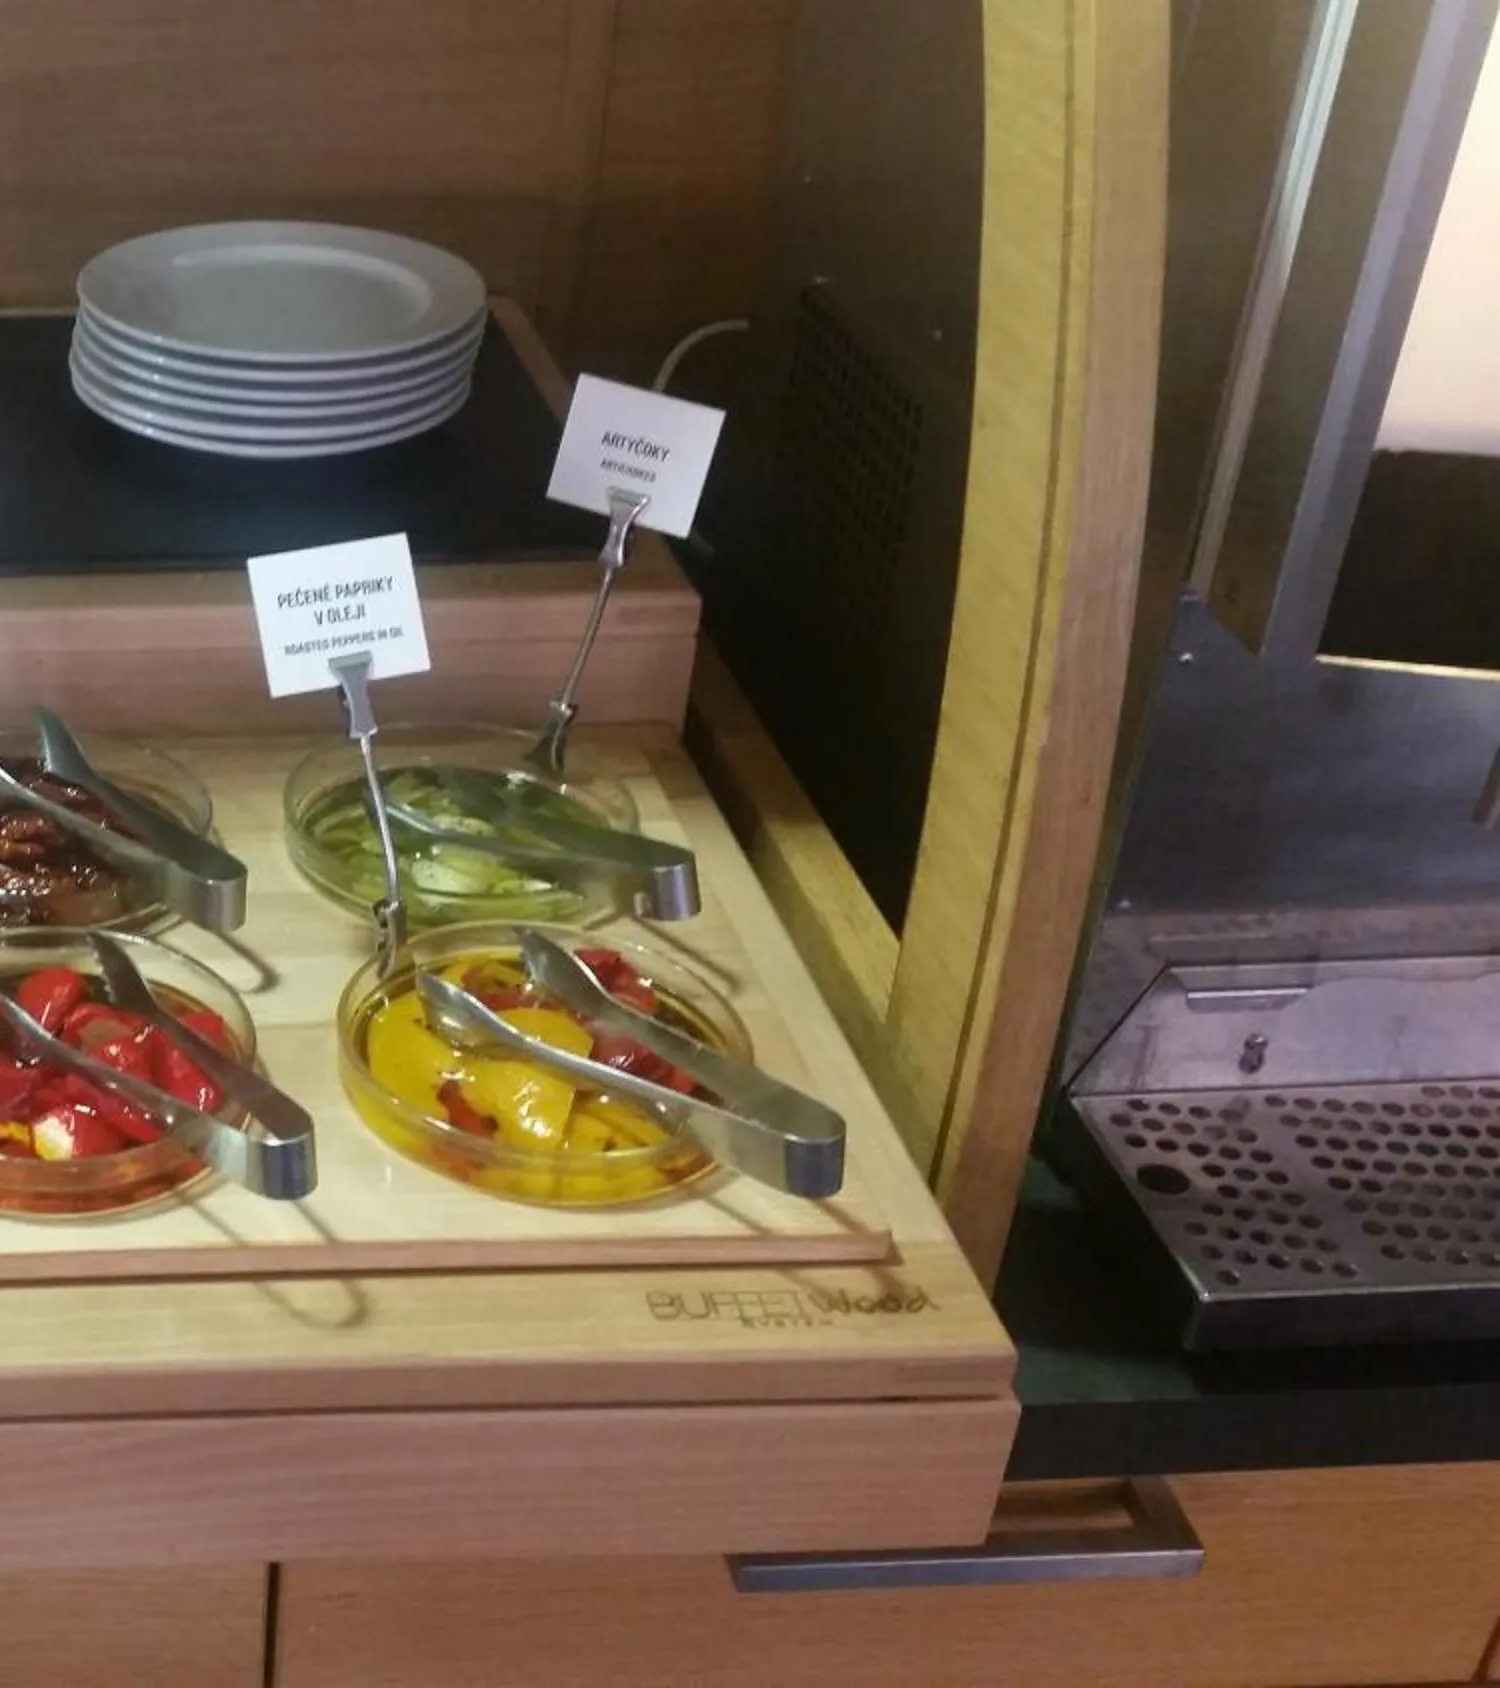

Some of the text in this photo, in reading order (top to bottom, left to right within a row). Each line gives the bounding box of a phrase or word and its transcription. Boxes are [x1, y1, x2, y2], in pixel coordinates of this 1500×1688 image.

[277, 575, 393, 609] PEČENÉ PAPRIKY
[314, 603, 366, 626] V OLEJI
